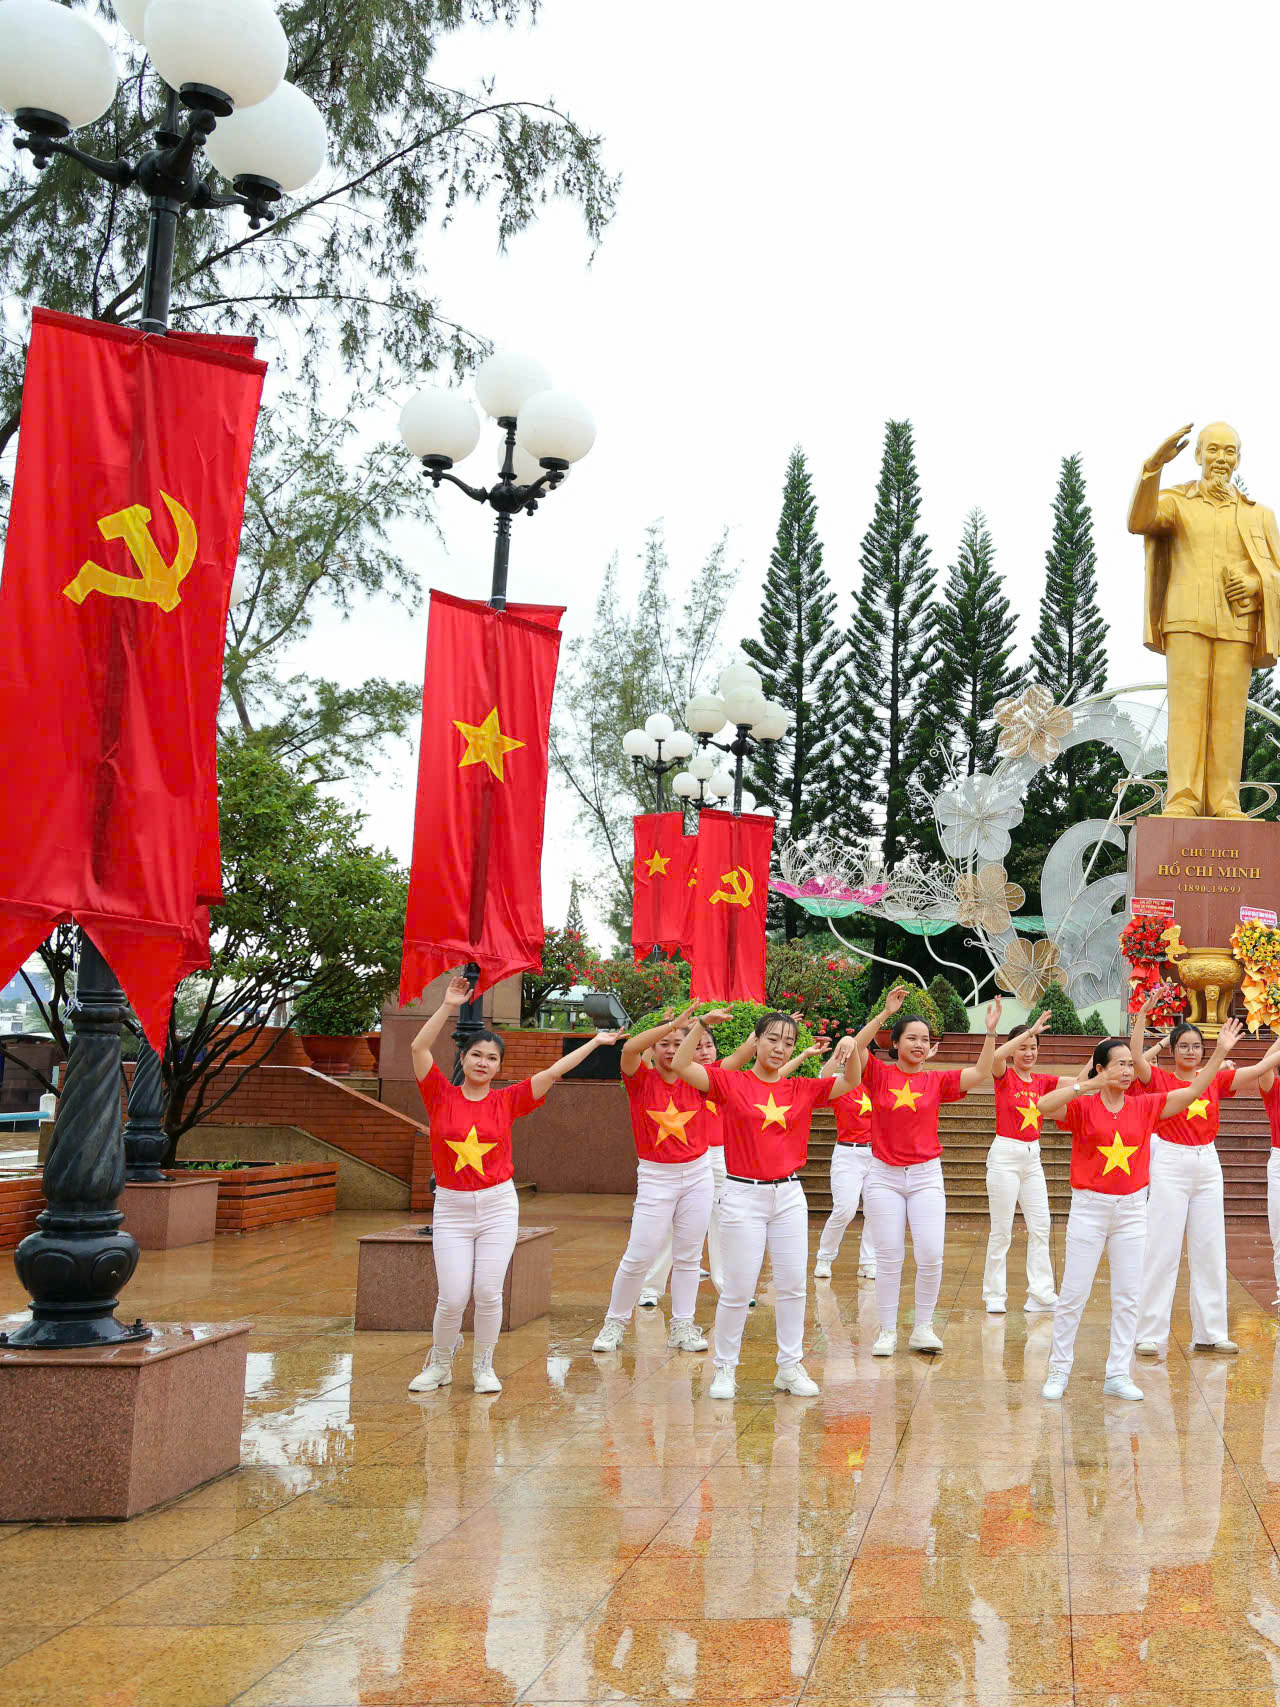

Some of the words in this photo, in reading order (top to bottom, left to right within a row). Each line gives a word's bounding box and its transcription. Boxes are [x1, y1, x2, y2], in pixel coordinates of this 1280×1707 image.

[1181, 844, 1207, 857] CHỦ
[1209, 848, 1240, 860] TỊCH
[1158, 860, 1181, 876] HỒ
[1185, 864, 1214, 877] CHÍ
[1217, 866, 1261, 879] MINH
